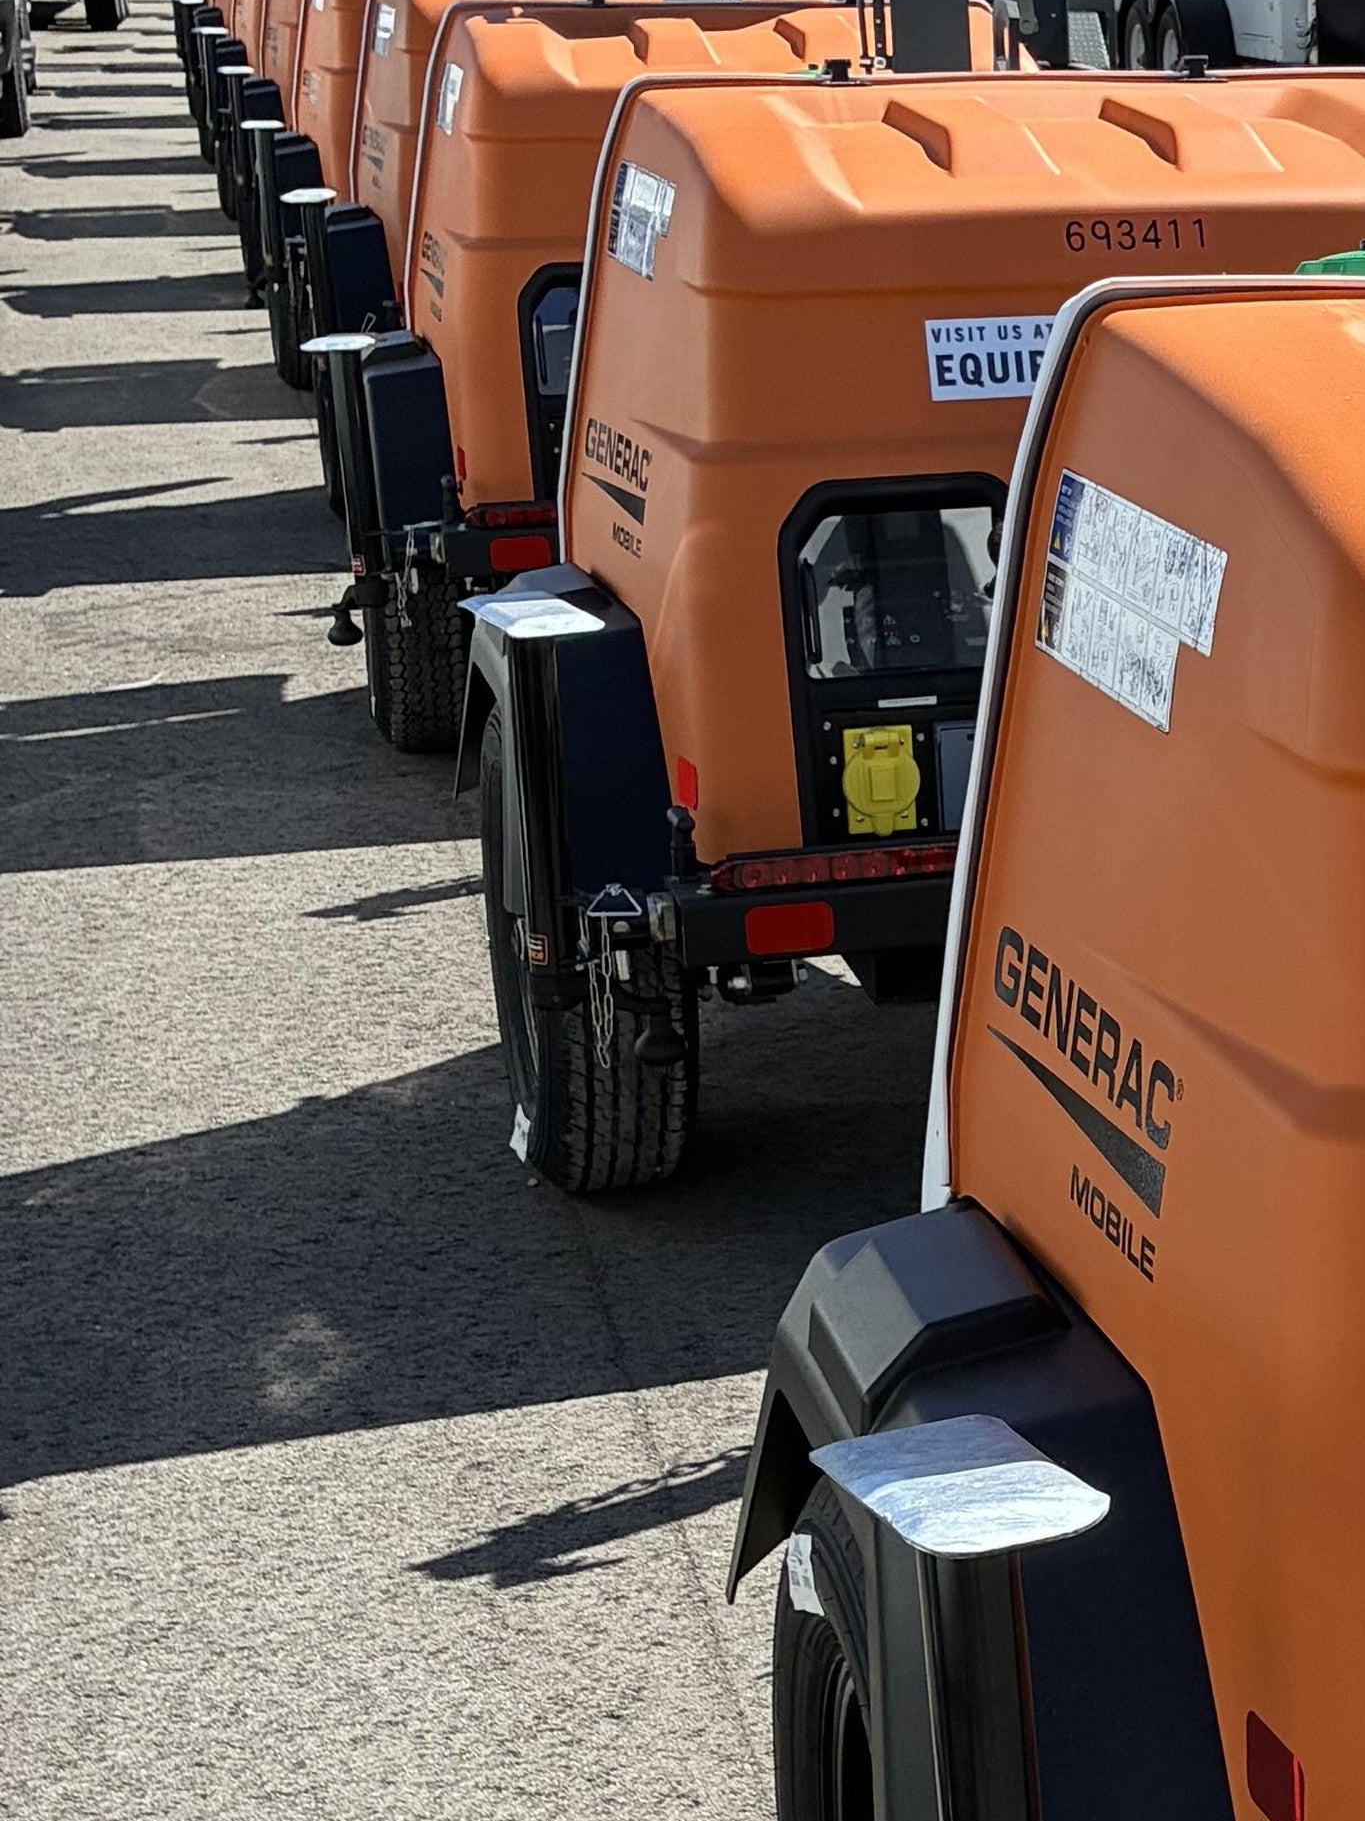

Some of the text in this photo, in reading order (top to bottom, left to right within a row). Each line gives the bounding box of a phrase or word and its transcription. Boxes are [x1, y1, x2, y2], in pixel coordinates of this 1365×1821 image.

[1065, 217, 1206, 252] 693411
[930, 326, 986, 343] VISIT
[997, 324, 1022, 340] US
[585, 418, 650, 492] GENERAC
[612, 521, 642, 559] MOBILE
[993, 926, 1175, 1151] GENERAC
[1070, 1164, 1156, 1283] MOBILE
